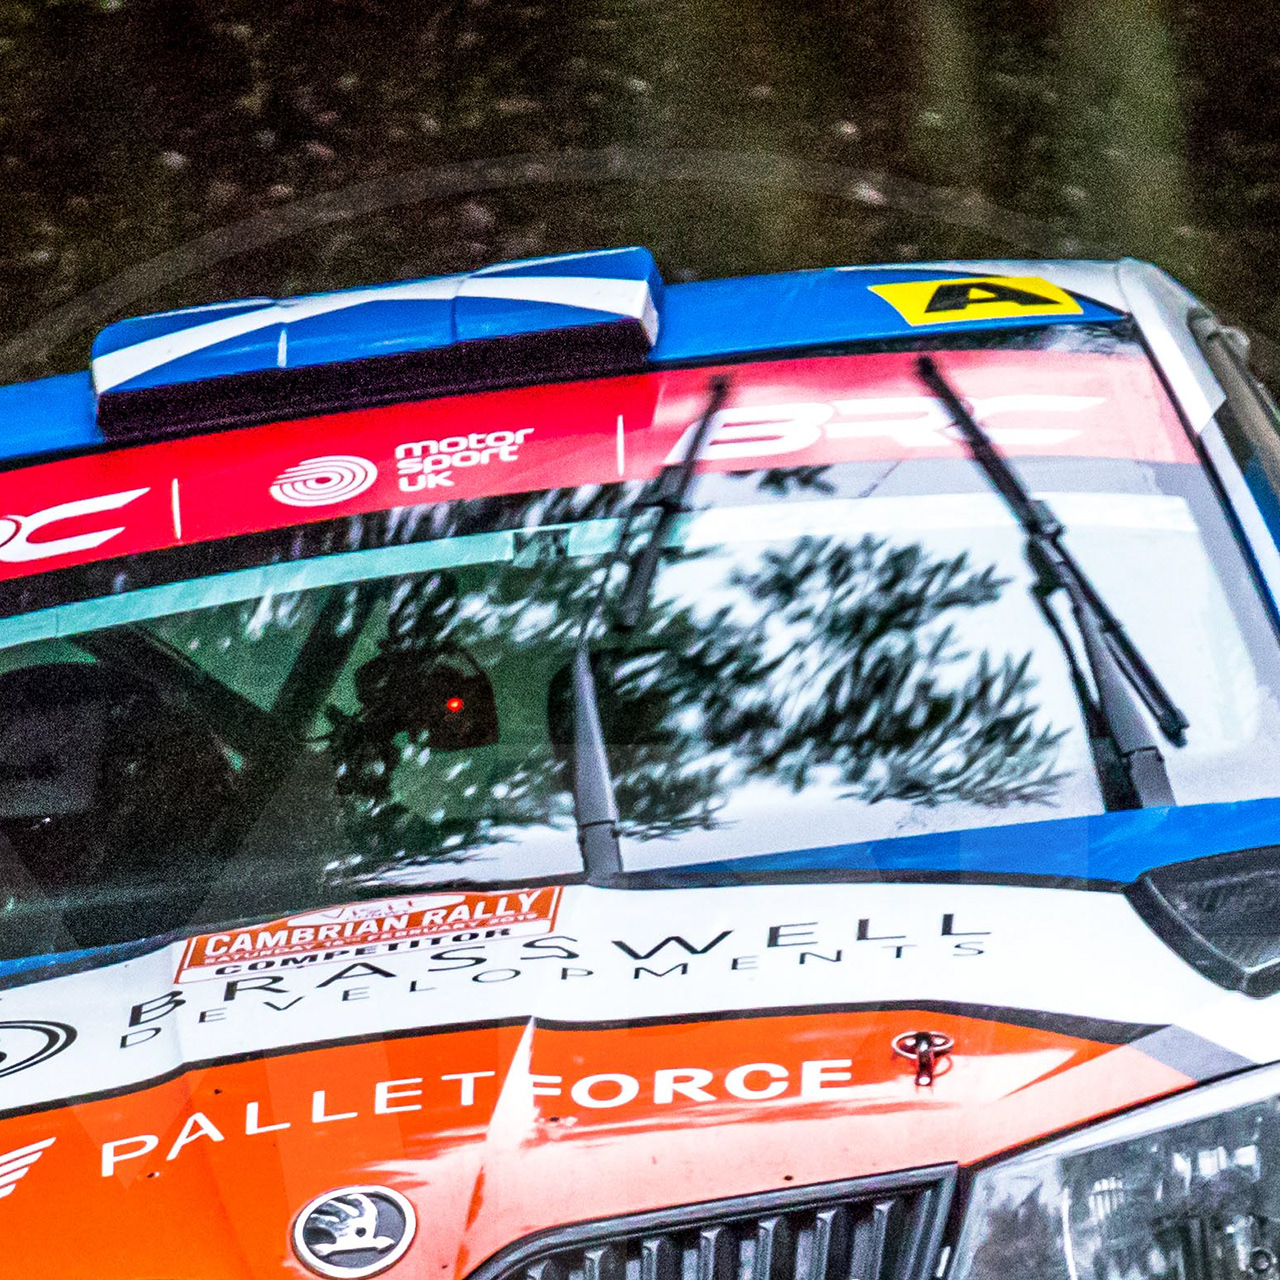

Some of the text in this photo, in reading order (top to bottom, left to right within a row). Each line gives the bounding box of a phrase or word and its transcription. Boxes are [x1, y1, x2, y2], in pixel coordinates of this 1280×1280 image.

[924, 282, 1062, 313] A
[395, 428, 534, 459] motor
[663, 396, 1108, 464] BRC
[397, 445, 519, 474] sport
[398, 471, 455, 492] UK
[204, 913, 408, 957] CAMBRIAN
[421, 891, 539, 927] RALLY
[129, 912, 992, 1026] BRASSWELL
[215, 927, 510, 976] COMPETITOR
[120, 941, 985, 1048] DEVELOPMENTS
